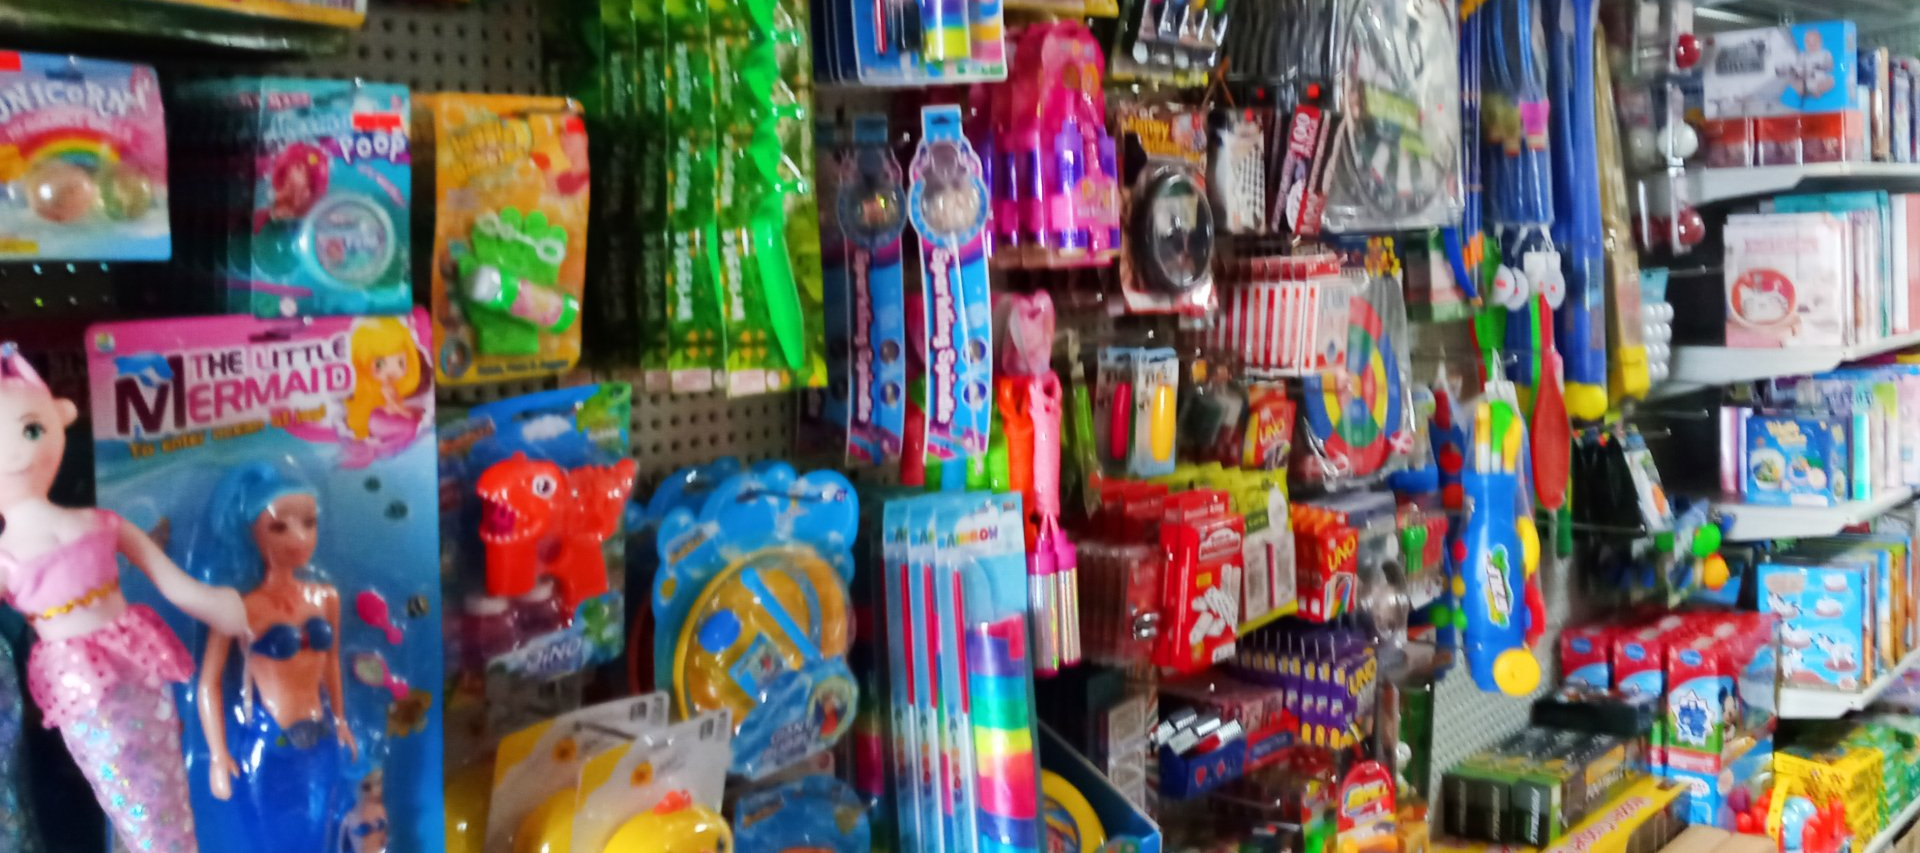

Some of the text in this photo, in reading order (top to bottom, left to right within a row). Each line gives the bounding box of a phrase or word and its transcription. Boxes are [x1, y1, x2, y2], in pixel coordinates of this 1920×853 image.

[340, 126, 406, 164] POOP
[191, 334, 347, 380] THE LITTLE
[114, 354, 353, 436] MERMAID
[1327, 533, 1357, 574] UNO
[1347, 655, 1377, 697] UNO
